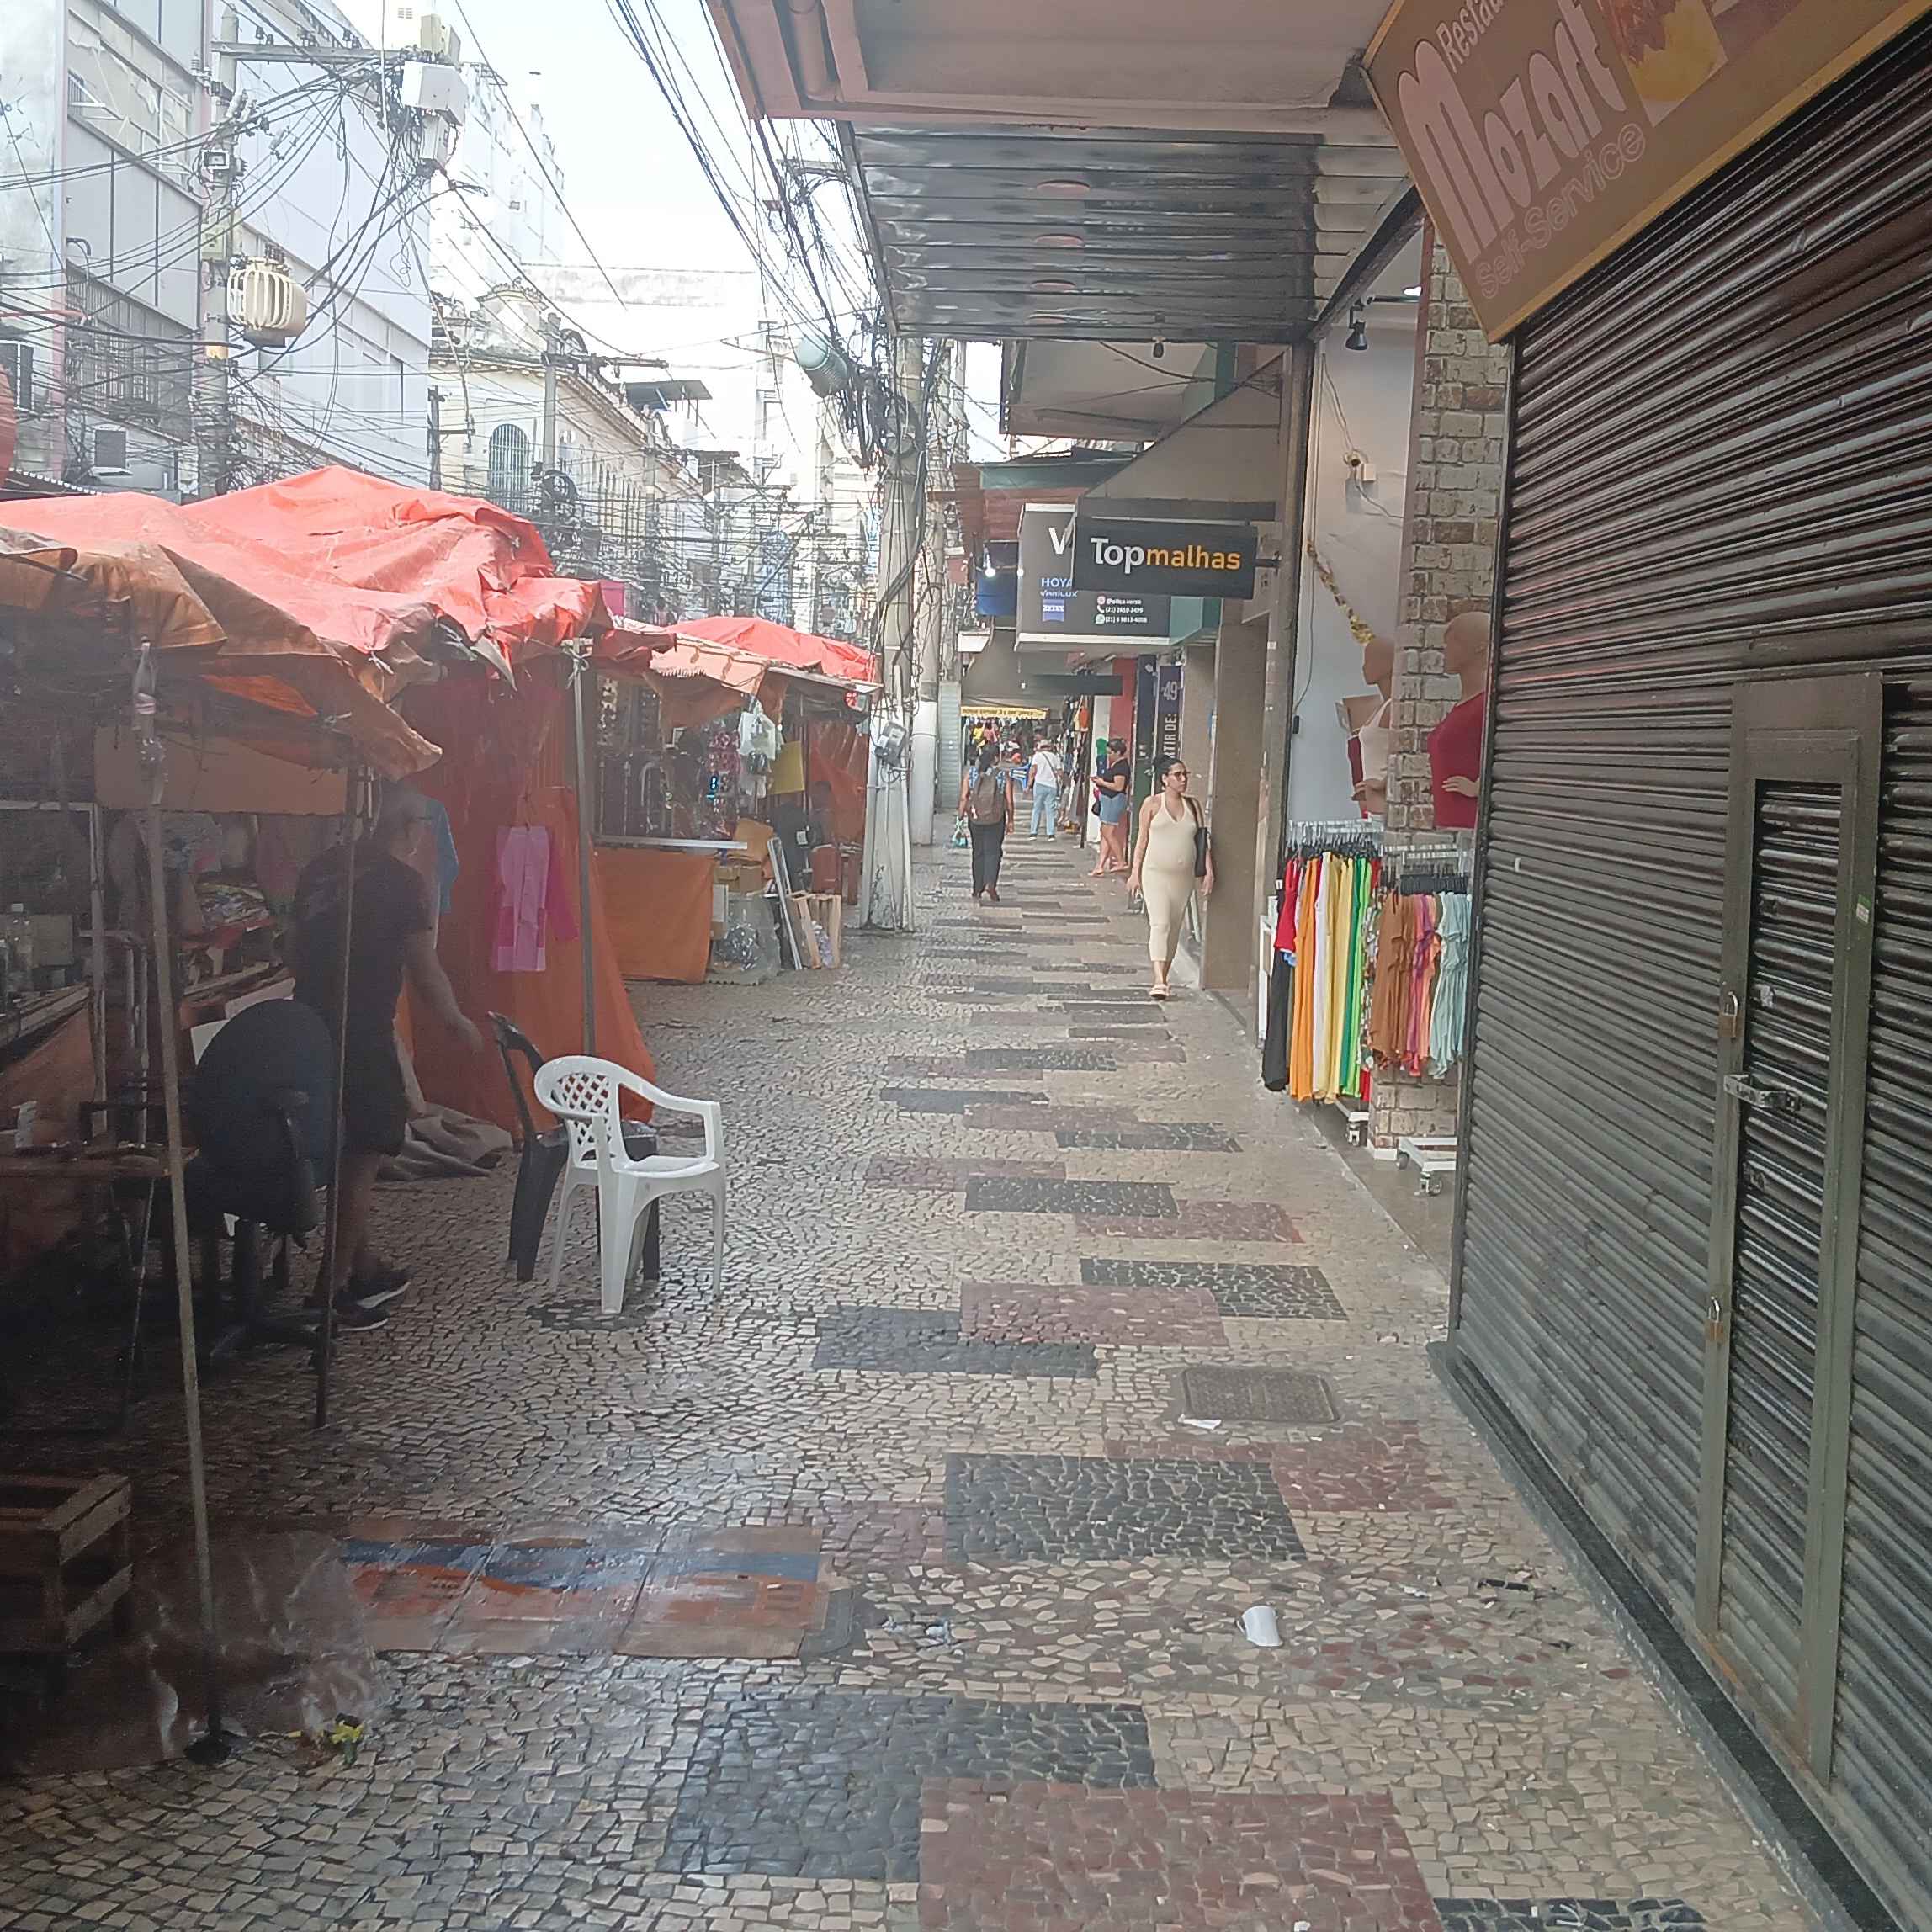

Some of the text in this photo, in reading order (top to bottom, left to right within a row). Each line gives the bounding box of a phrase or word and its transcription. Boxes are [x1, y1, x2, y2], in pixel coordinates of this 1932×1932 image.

[1398, 0, 1627, 266] Mozart
[1477, 123, 1647, 300] Self-Service
[1090, 537, 1242, 575] Topmalhas
